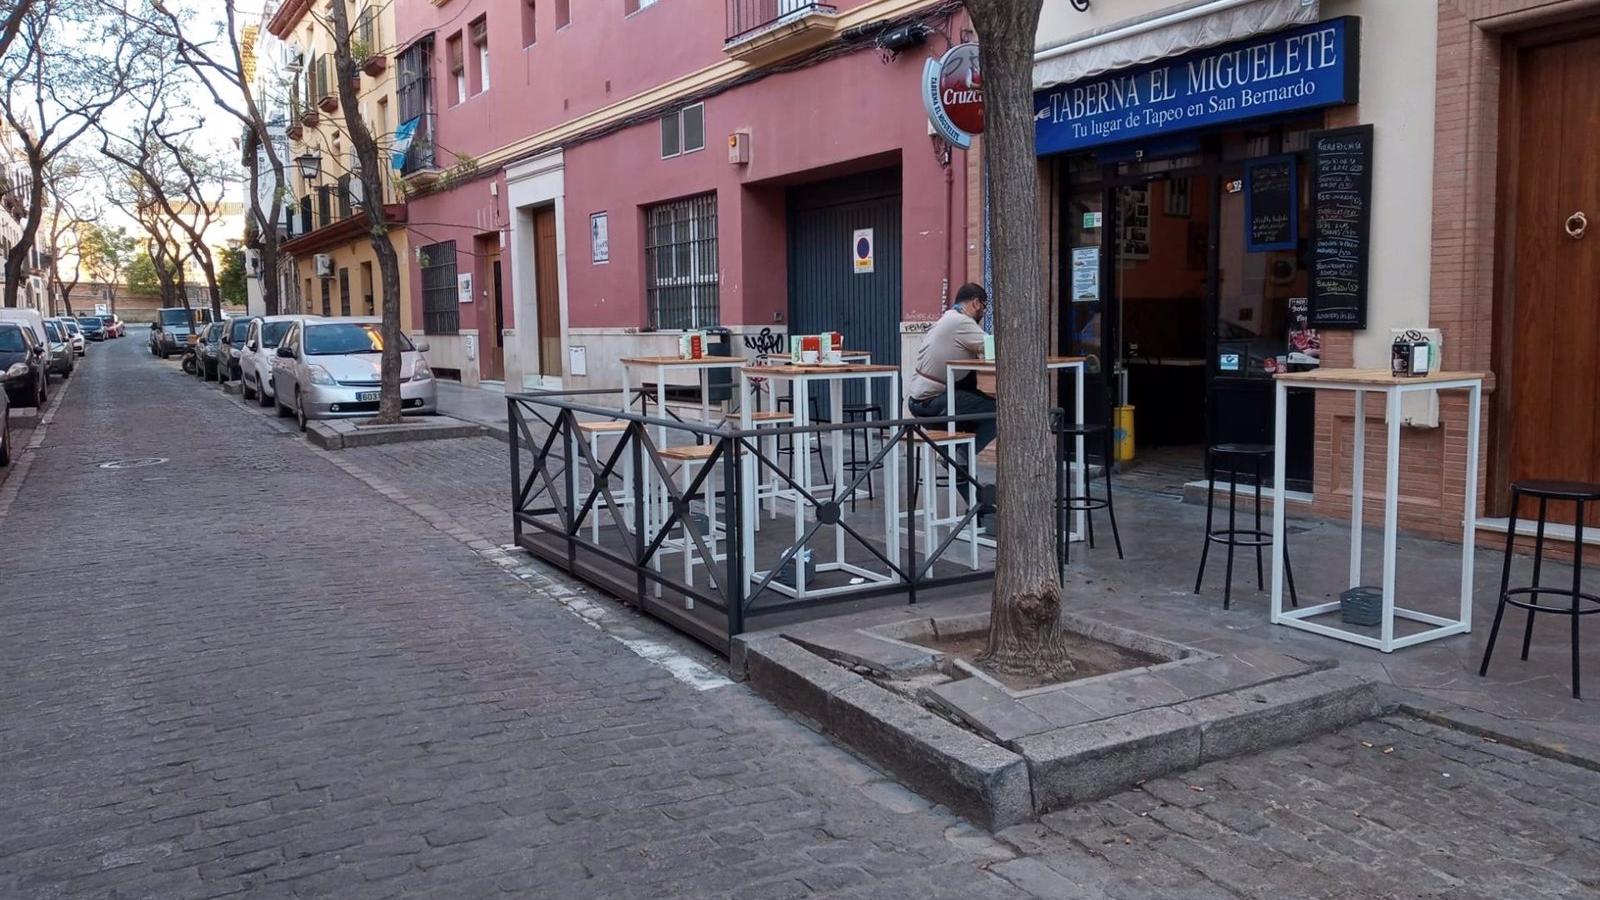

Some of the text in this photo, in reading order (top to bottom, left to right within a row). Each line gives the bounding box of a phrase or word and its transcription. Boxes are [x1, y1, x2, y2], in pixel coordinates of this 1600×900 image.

[931, 76, 940, 107] TABERNA
[938, 113, 961, 141] MIGUELETE
[1050, 28, 1336, 124] TABERNA EL MIGUELETE
[1072, 78, 1316, 139] Tu lugar de Tapeo en San Bernardo
